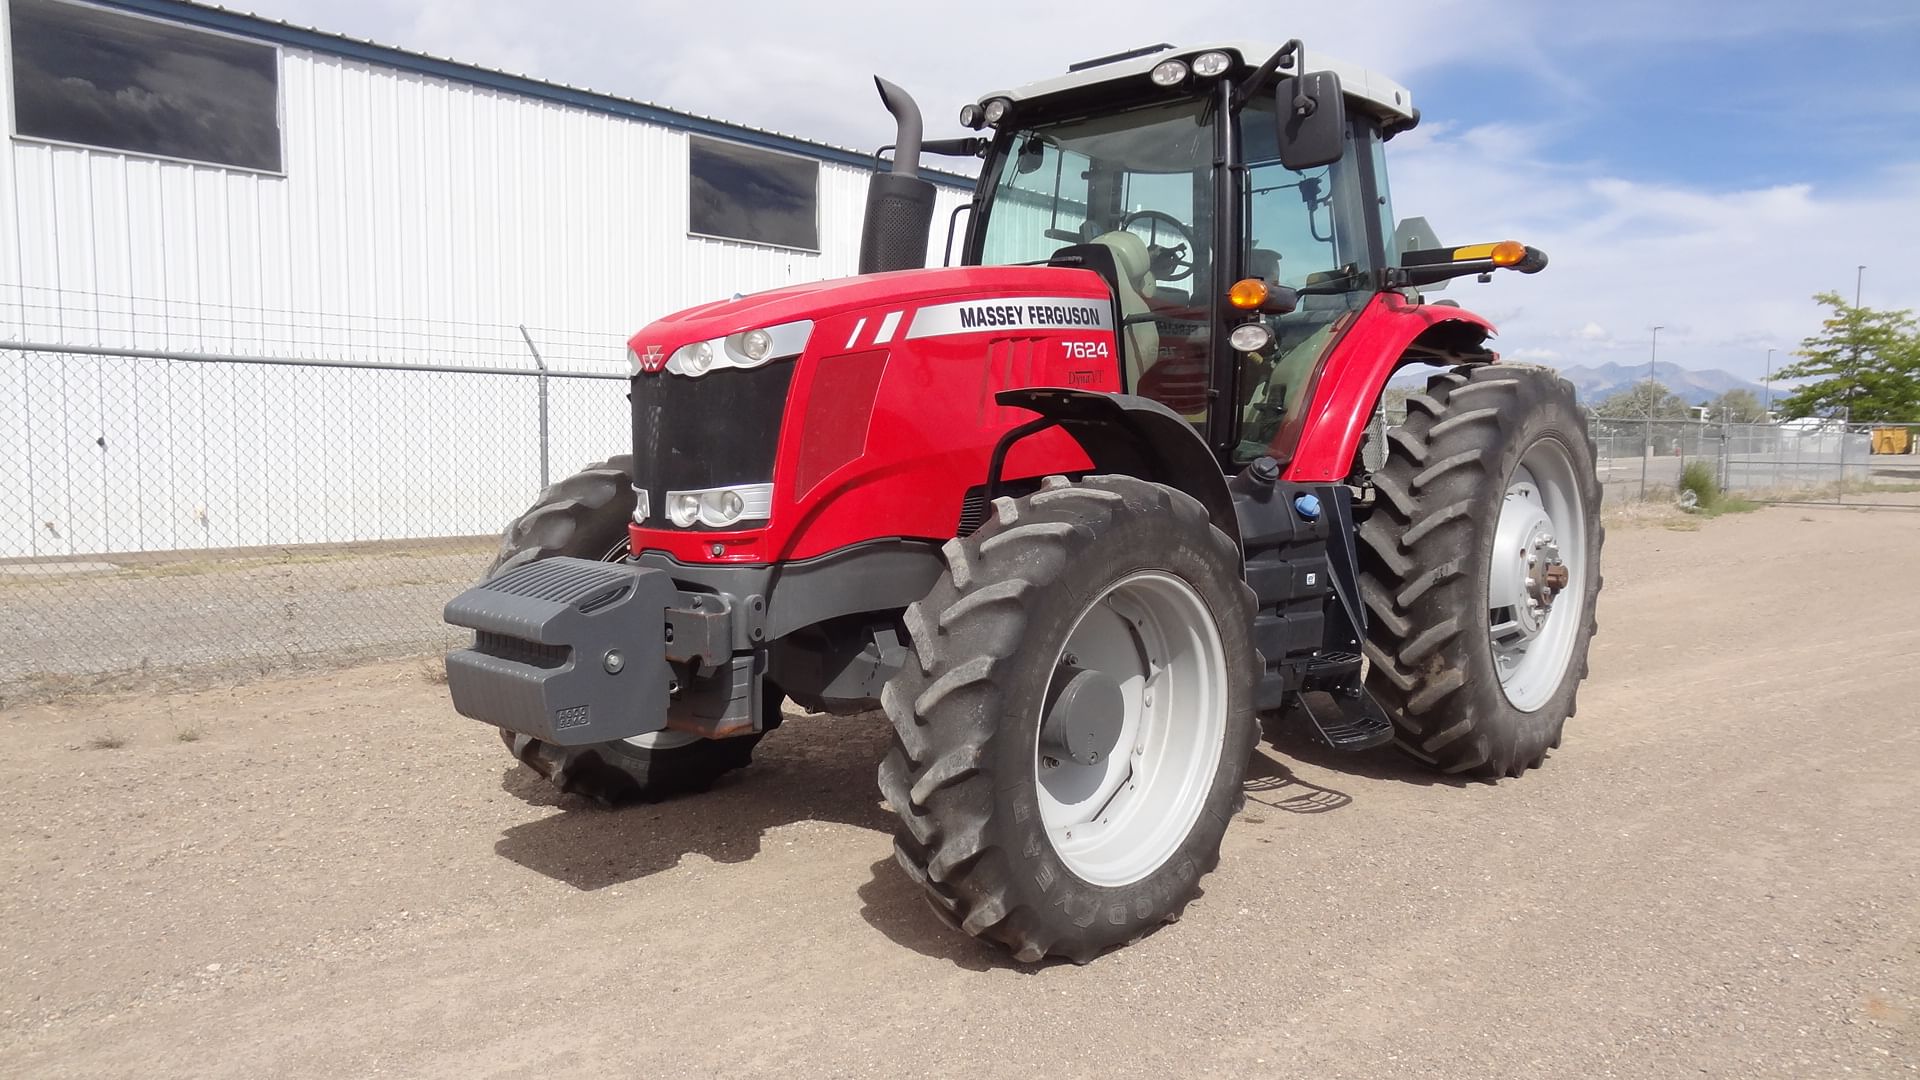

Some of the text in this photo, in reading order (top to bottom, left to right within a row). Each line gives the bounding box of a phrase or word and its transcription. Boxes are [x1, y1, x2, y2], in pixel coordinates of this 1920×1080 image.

[959, 305, 1101, 328] MASSEY FERGUSON
[1061, 341, 1109, 358] 7624
